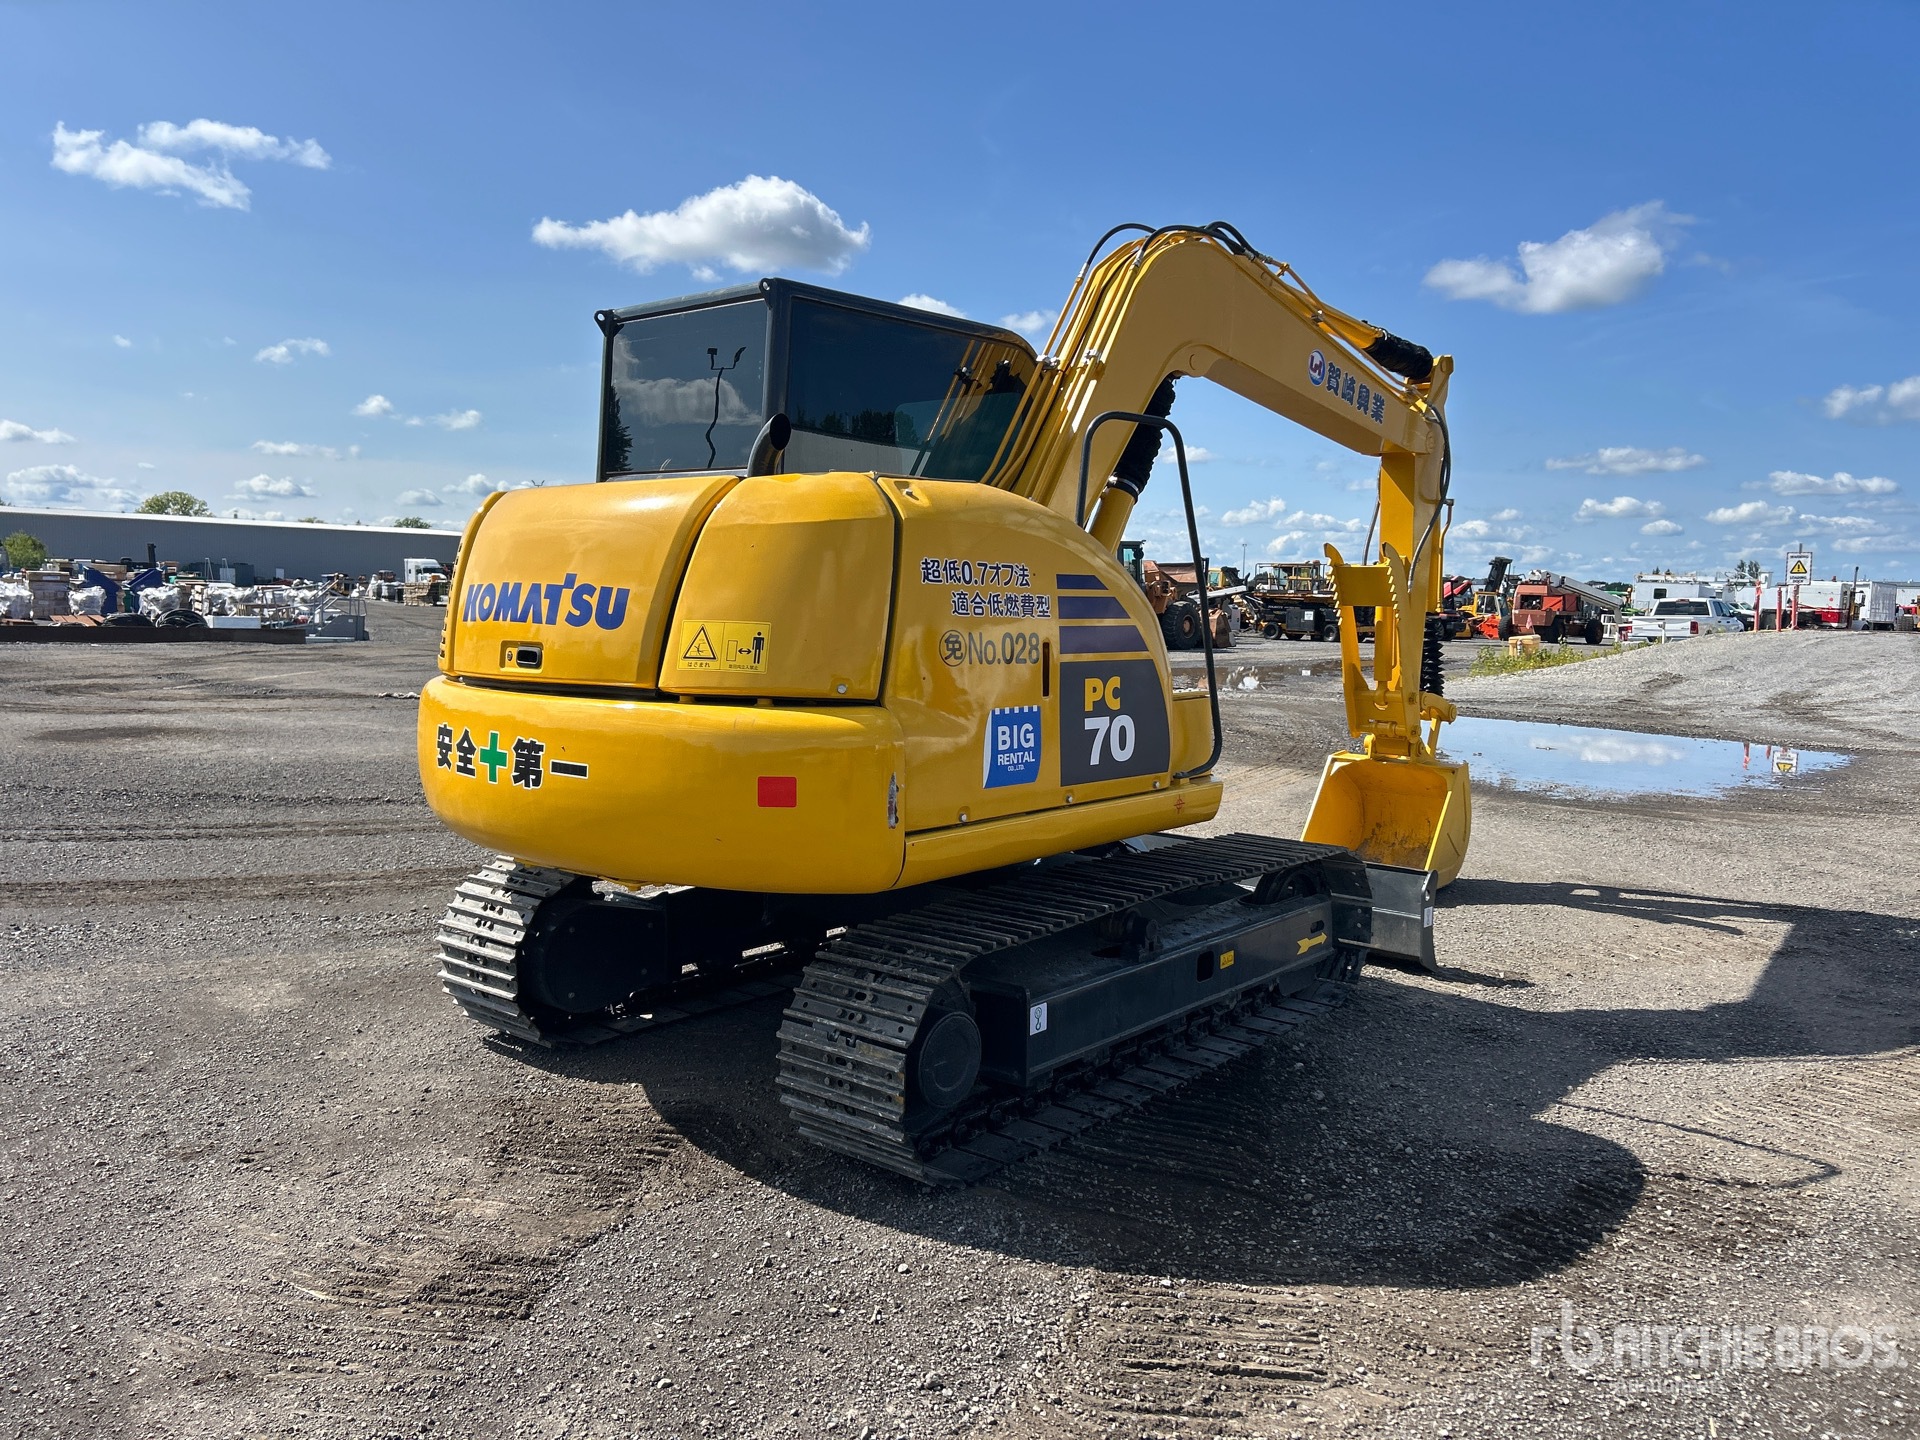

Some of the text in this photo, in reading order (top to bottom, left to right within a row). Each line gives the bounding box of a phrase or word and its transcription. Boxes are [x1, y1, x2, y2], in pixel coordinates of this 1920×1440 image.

[463, 573, 630, 630] KOMATSU
[951, 591, 1051, 618] 適合低燃費型
[1085, 676, 1120, 711] PC
[997, 723, 1035, 750] BIG
[1085, 714, 1135, 766] 70
[997, 751, 1036, 766] RENTAL
